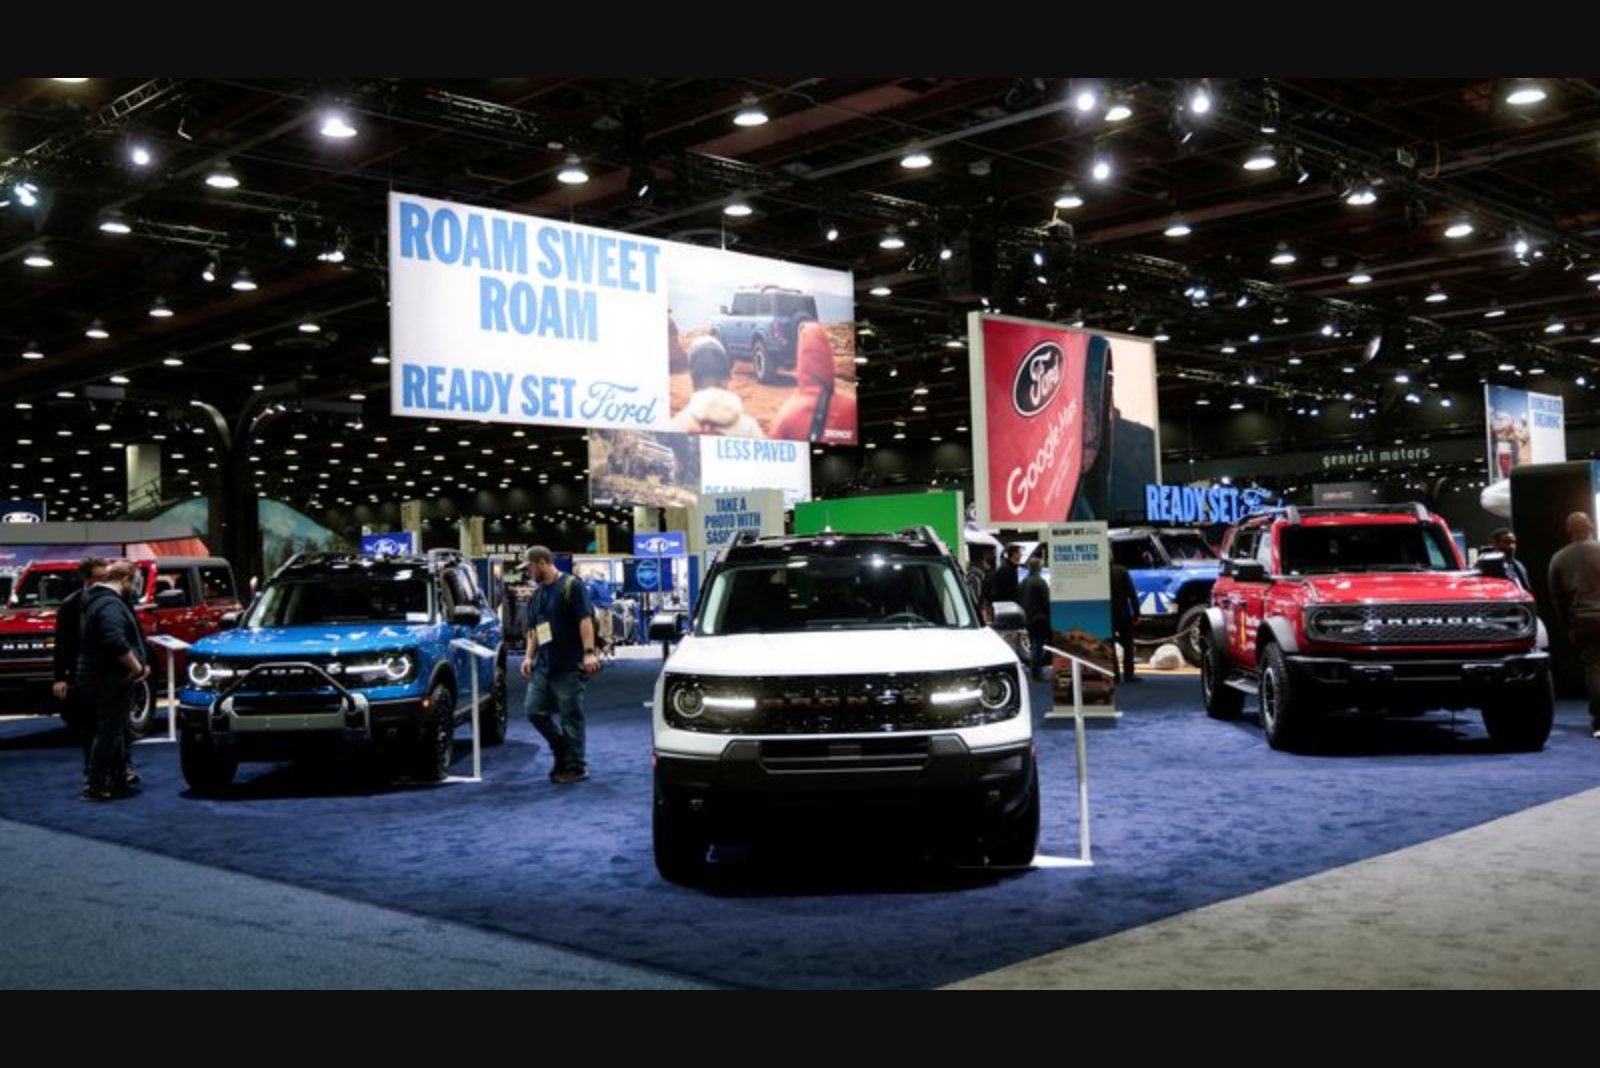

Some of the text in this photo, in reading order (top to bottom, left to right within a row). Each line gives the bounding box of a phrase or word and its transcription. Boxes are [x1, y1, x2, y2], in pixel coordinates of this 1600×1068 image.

[400, 201, 660, 294] ROAM SWEET
[479, 275, 598, 342] ROAM
[402, 363, 657, 424] READY SET Ford
[717, 439, 797, 462] LESS PAVED
[1006, 422, 1061, 516] Google
[1322, 447, 1431, 468] general motors
[704, 512, 760, 528] PHOTO WITH
[716, 496, 747, 512] TAKE A
[1146, 484, 1206, 521] READY
[1209, 487, 1239, 523] SET
